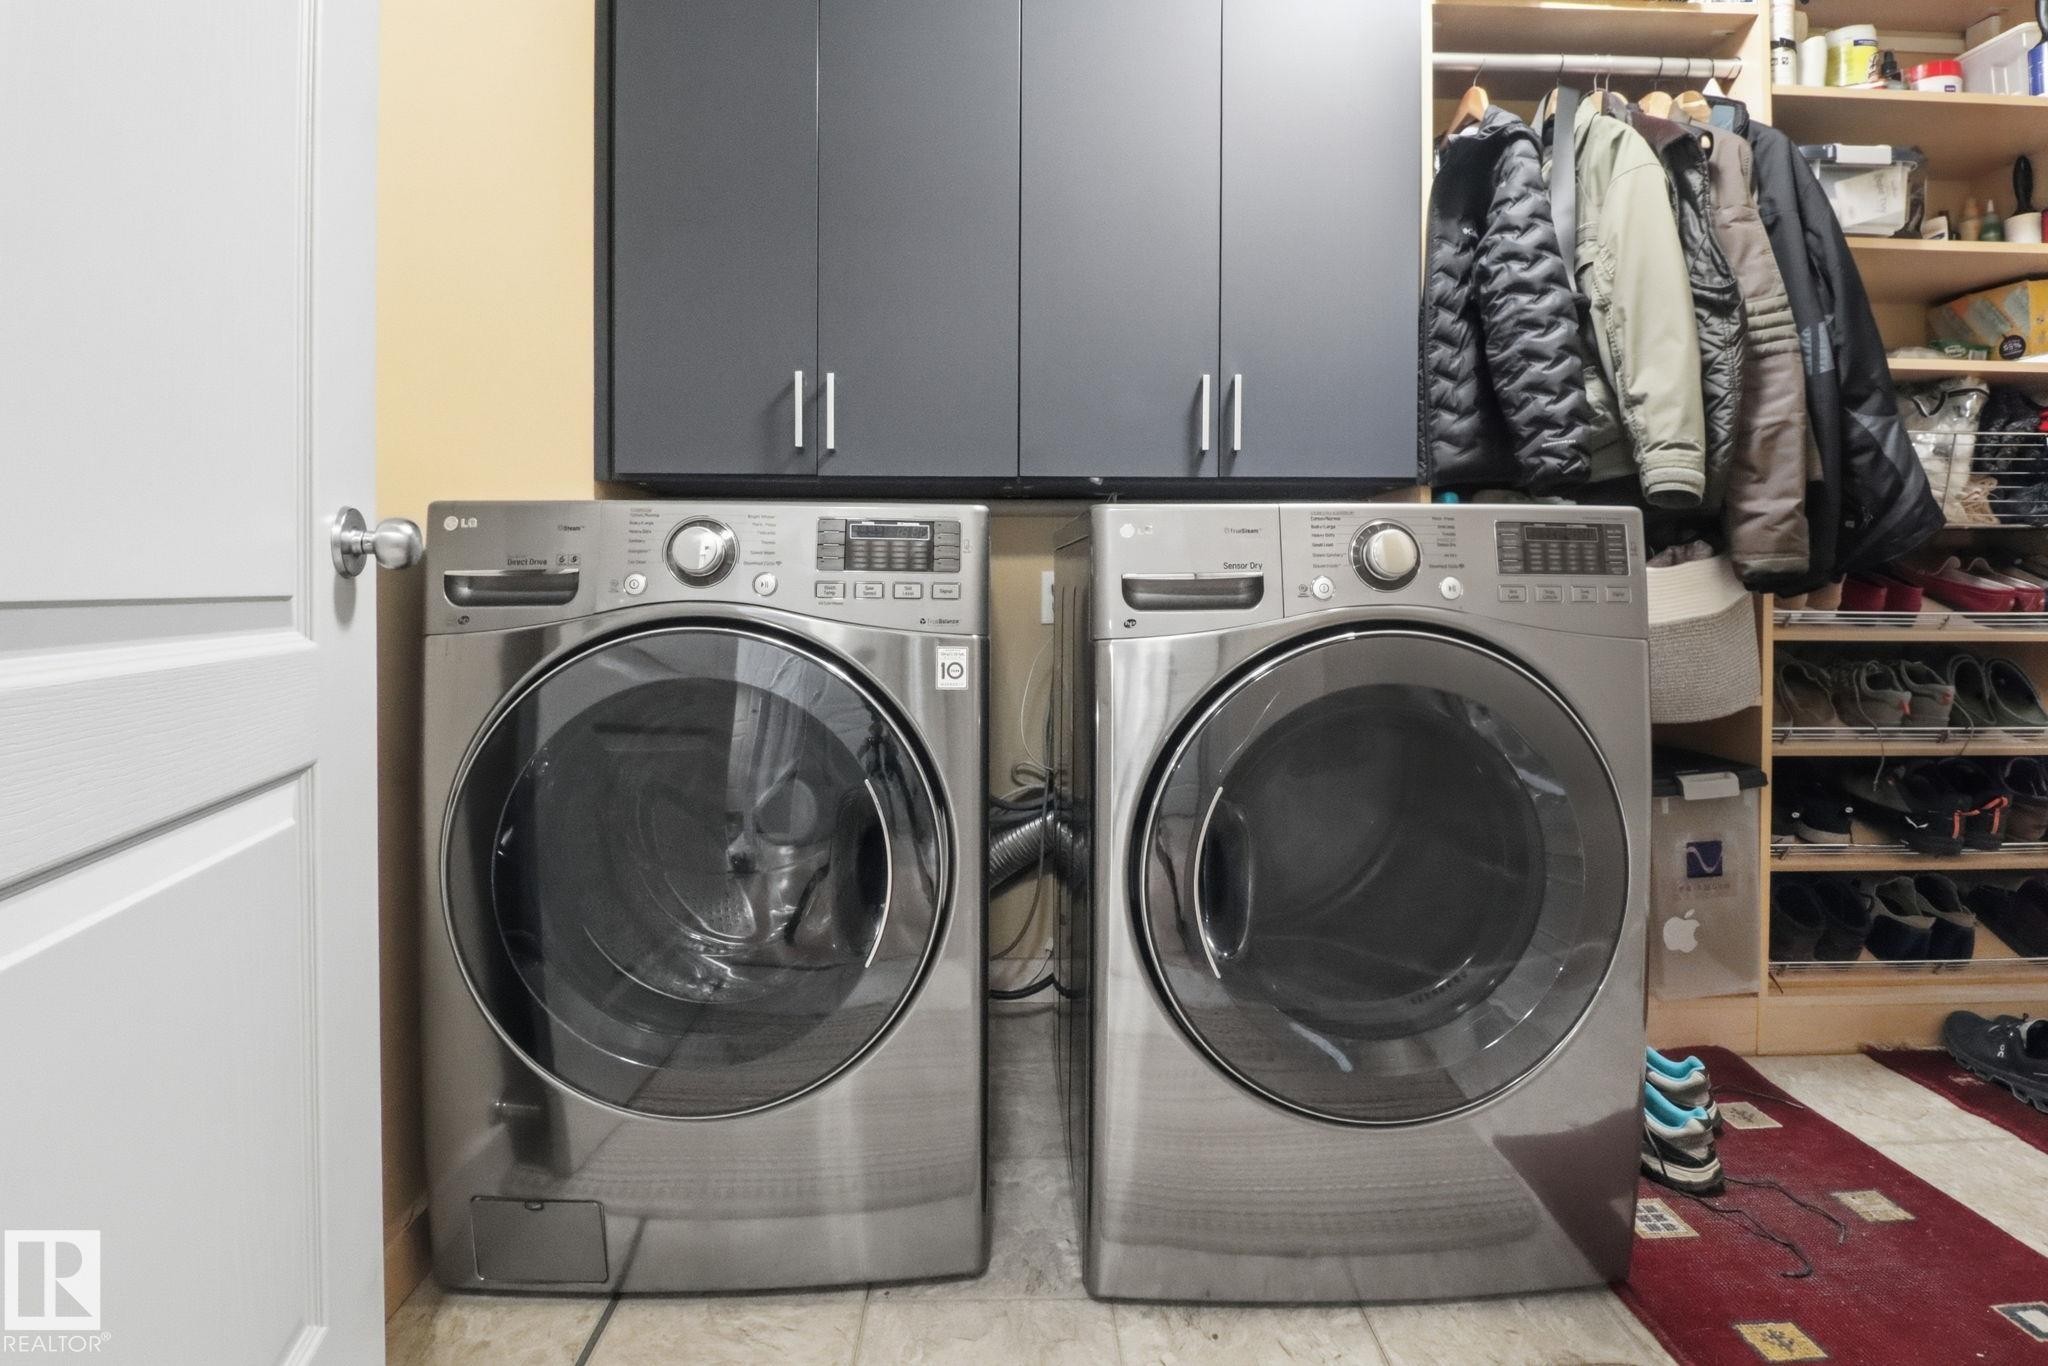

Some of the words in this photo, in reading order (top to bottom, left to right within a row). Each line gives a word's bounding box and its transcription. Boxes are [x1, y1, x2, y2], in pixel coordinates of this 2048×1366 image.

[460, 517, 478, 529] LG
[507, 558, 528, 566] Direct
[529, 558, 548, 566] Drive
[1223, 561, 1248, 570] Sensor
[1249, 561, 1263, 571] Dry
